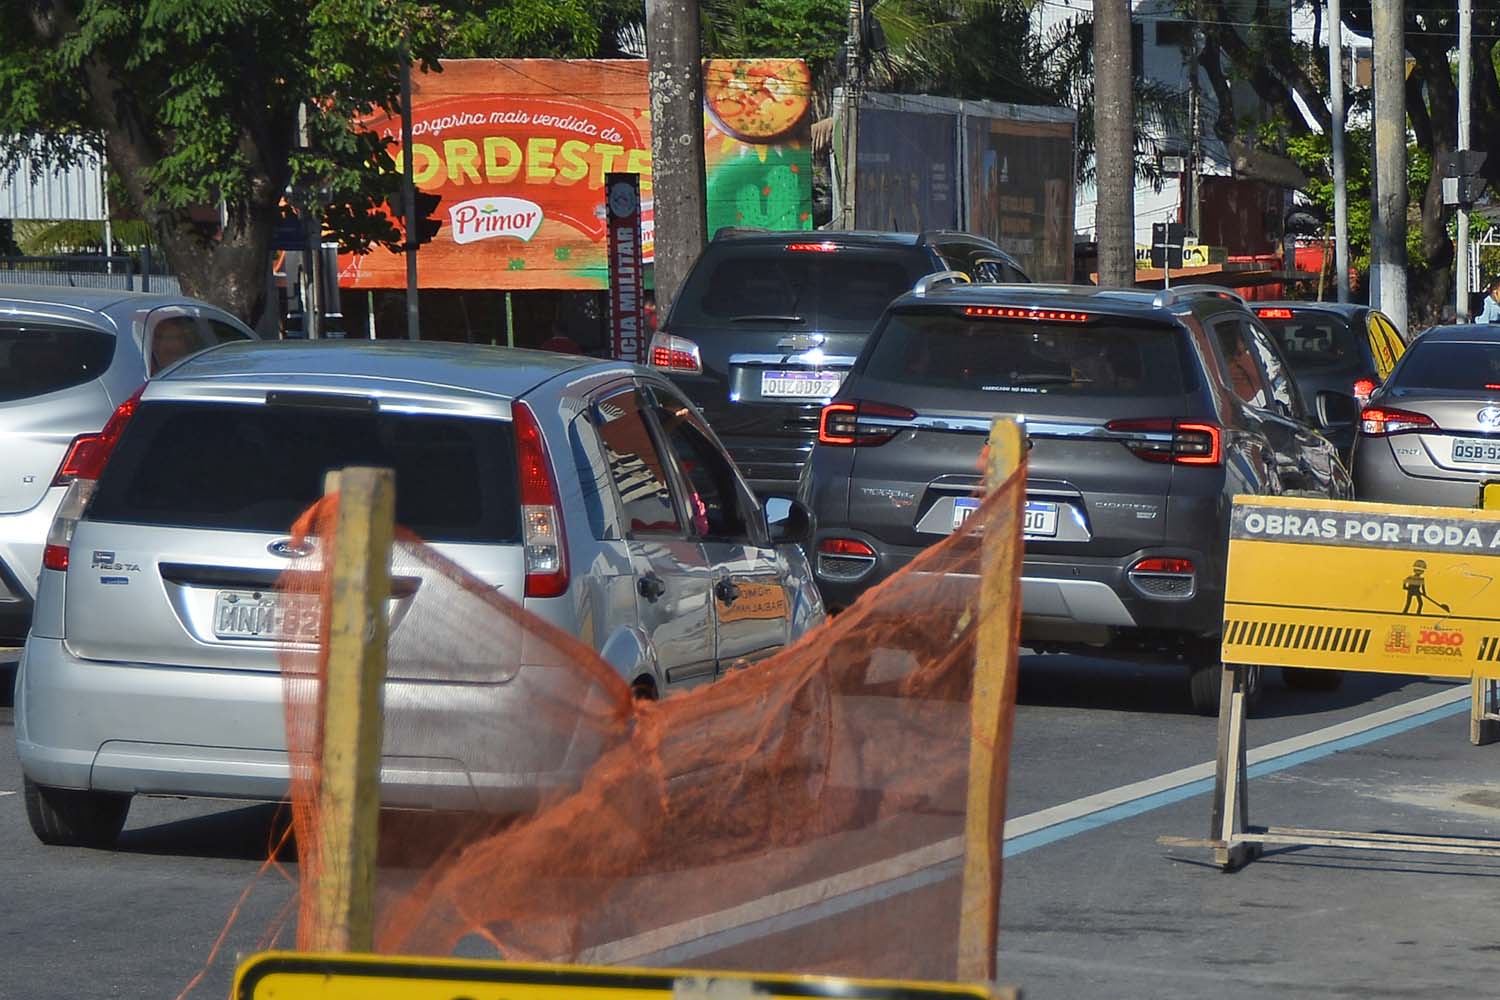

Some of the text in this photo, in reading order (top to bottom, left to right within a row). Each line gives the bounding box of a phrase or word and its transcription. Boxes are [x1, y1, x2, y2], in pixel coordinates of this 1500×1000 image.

[489, 109, 530, 124] mais
[532, 112, 598, 136] vendida
[600, 126, 624, 144] do
[364, 136, 654, 191] ORDESTE
[456, 204, 537, 234] Primor
[617, 227, 637, 363] ICIA MILITAR
[1244, 512, 1337, 539] OBRAS
[1344, 519, 1400, 542] POR
[1407, 522, 1483, 549] TODA
[1415, 645, 1463, 657] PESSOA
[1416, 630, 1465, 646] JOÃO
